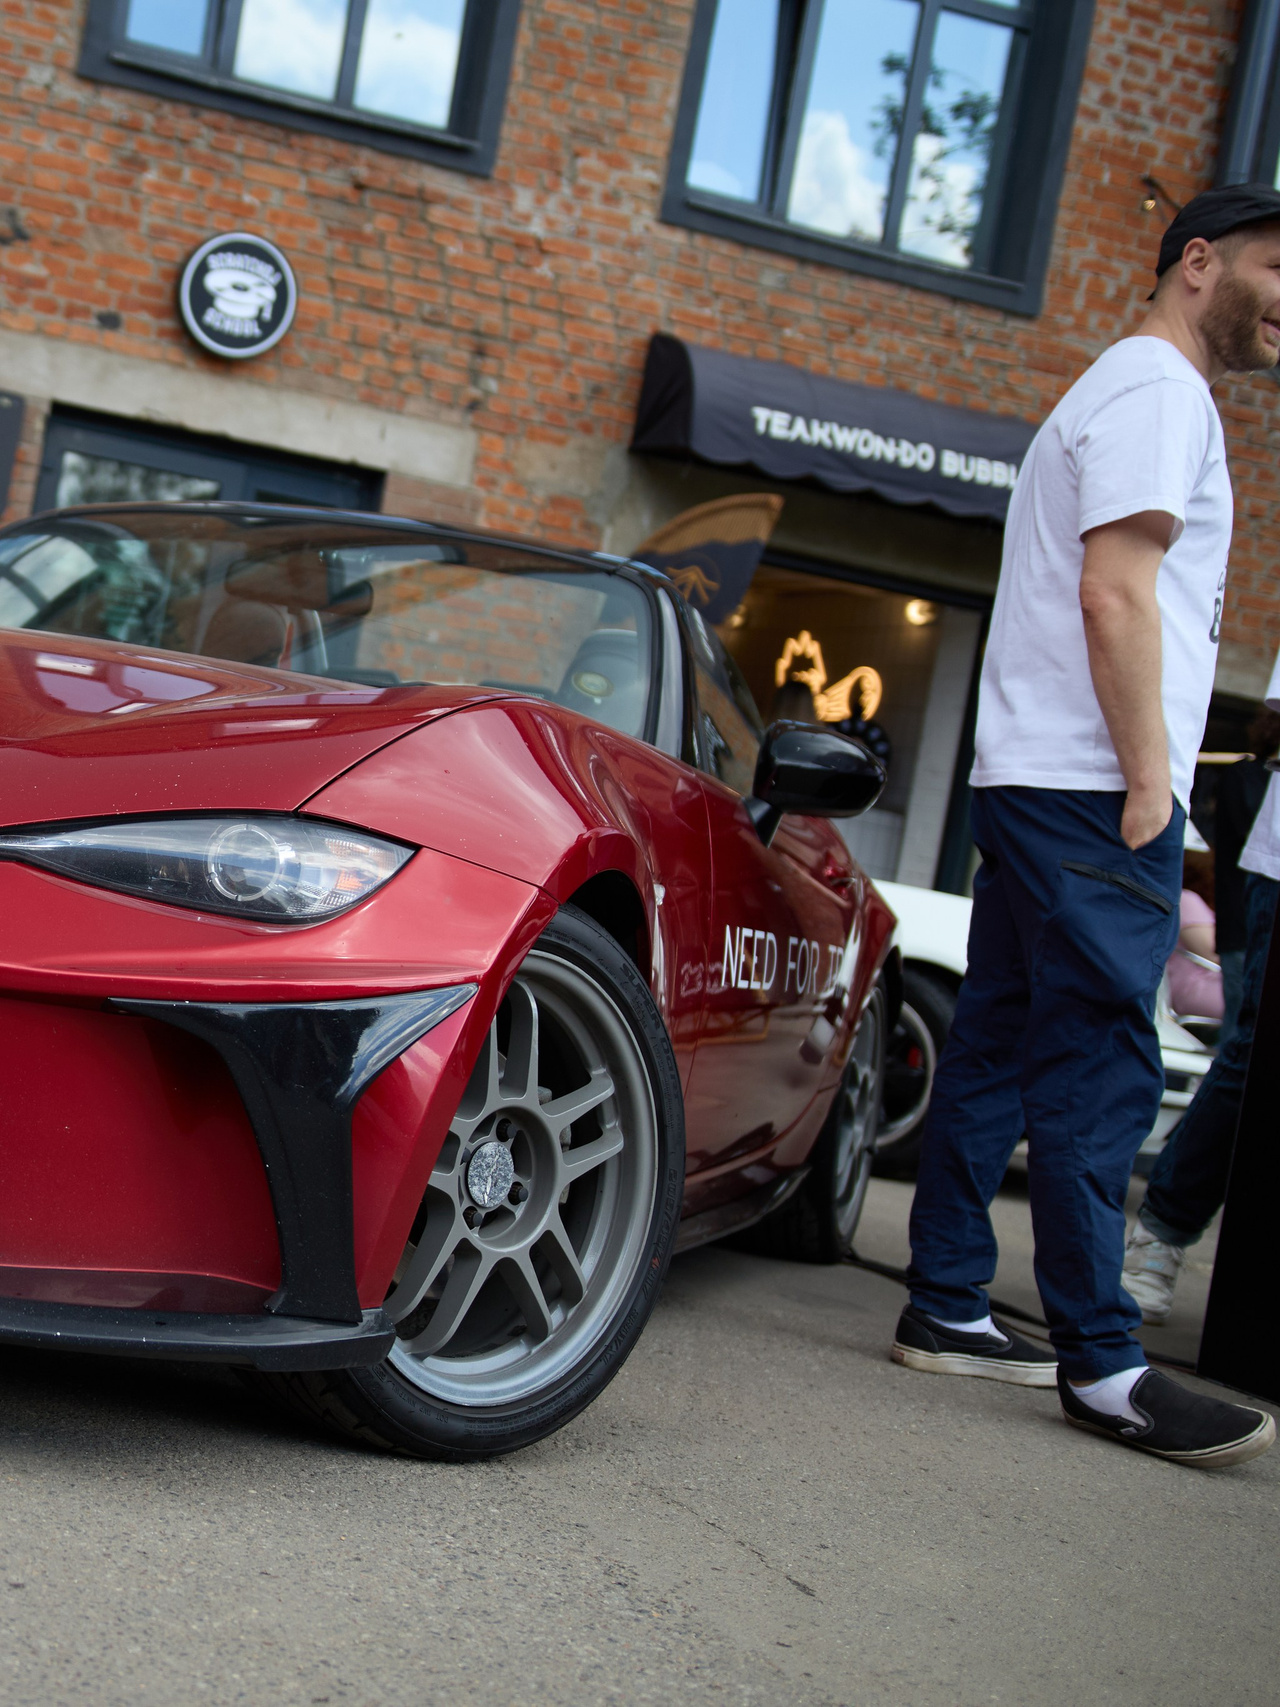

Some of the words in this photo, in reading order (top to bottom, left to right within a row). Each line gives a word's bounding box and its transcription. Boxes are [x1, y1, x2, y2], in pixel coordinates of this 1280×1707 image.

[202, 307, 262, 337] SCHOOL
[721, 924, 778, 991] NEED
[785, 936, 820, 994] FOR
